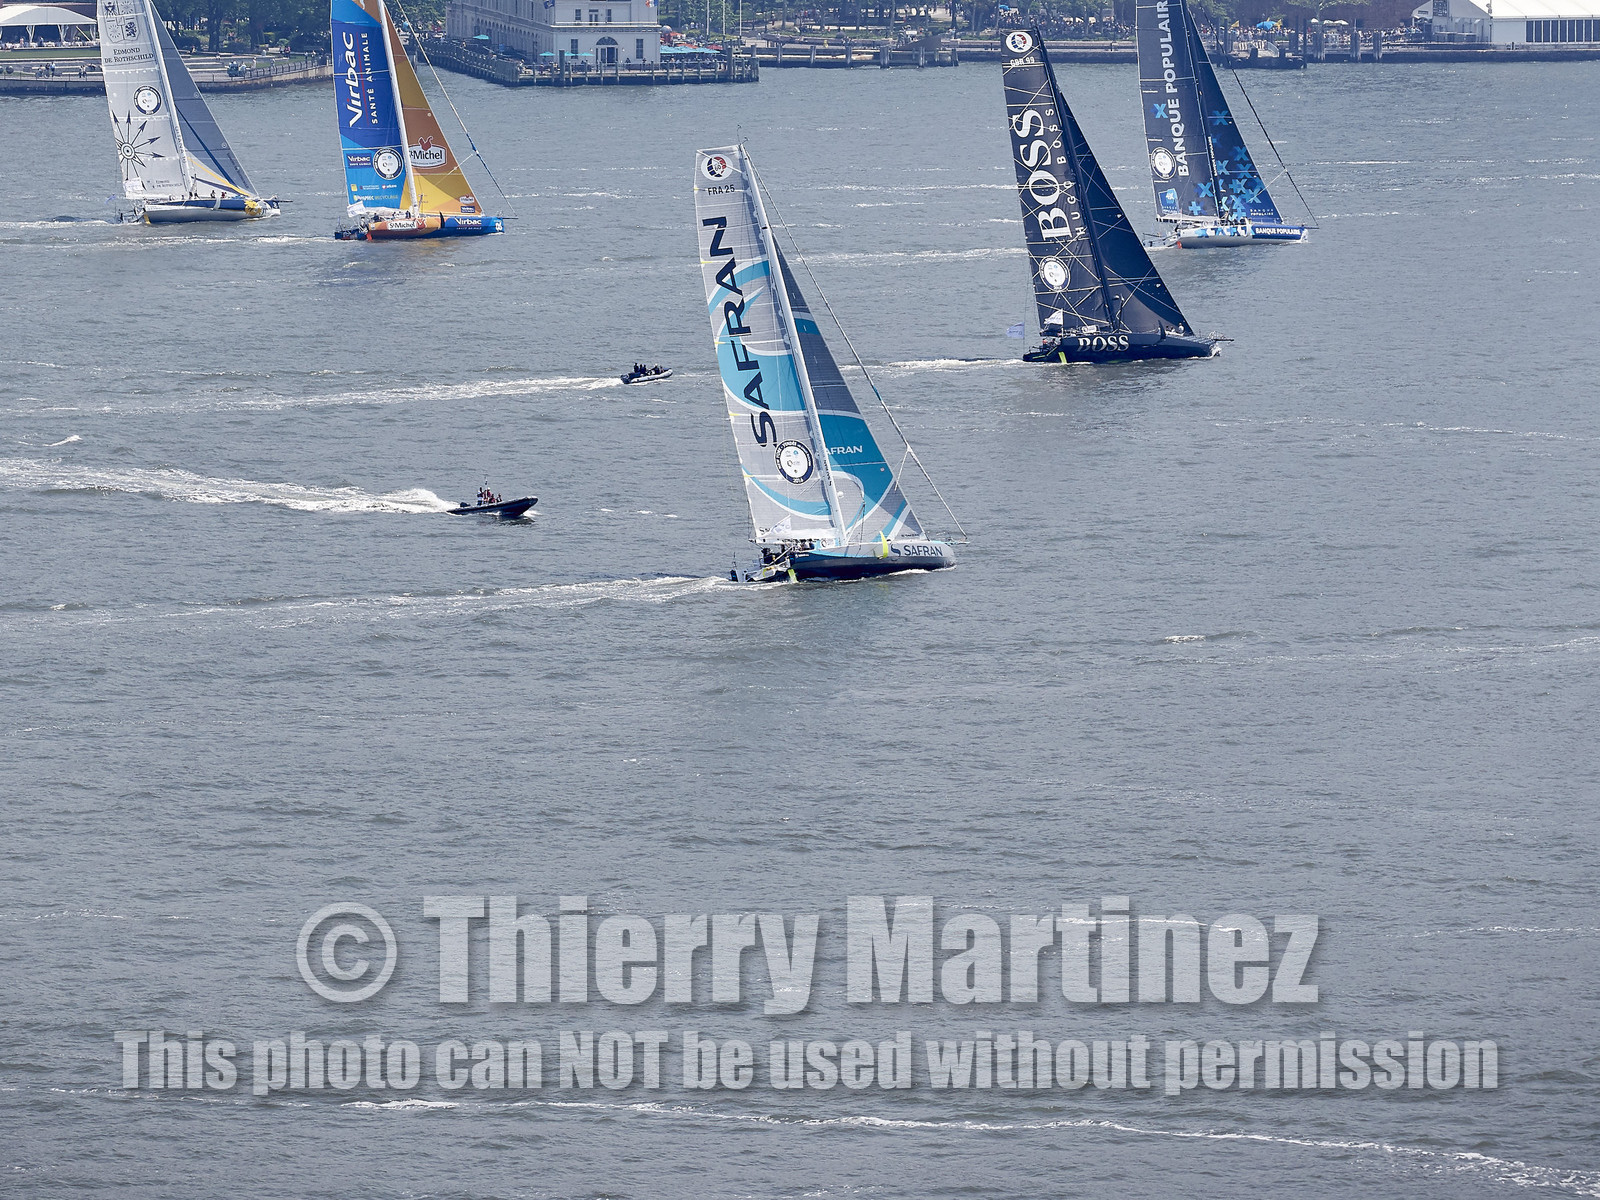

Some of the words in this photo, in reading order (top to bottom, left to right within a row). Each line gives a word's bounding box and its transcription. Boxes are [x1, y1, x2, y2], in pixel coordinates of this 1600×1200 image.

[113, 47, 141, 55] EDMOND
[113, 53, 154, 63] ROTHSCHILD
[361, 32, 373, 82] ANIMALE
[342, 31, 363, 128] Virbac
[367, 88, 379, 125] SANTÉ
[1044, 108, 1067, 165] BOSS
[1167, 98, 1190, 177] BANQUE
[708, 185, 724, 195] FRA
[725, 184, 735, 193] 25
[1012, 109, 1073, 242] BOSS
[1063, 180, 1086, 235] HUGO
[1255, 227, 1276, 235] BANQUE
[702, 216, 777, 448] SAFRAN
[1077, 335, 1130, 352] BOSS
[903, 545, 943, 557] SAFRAN
